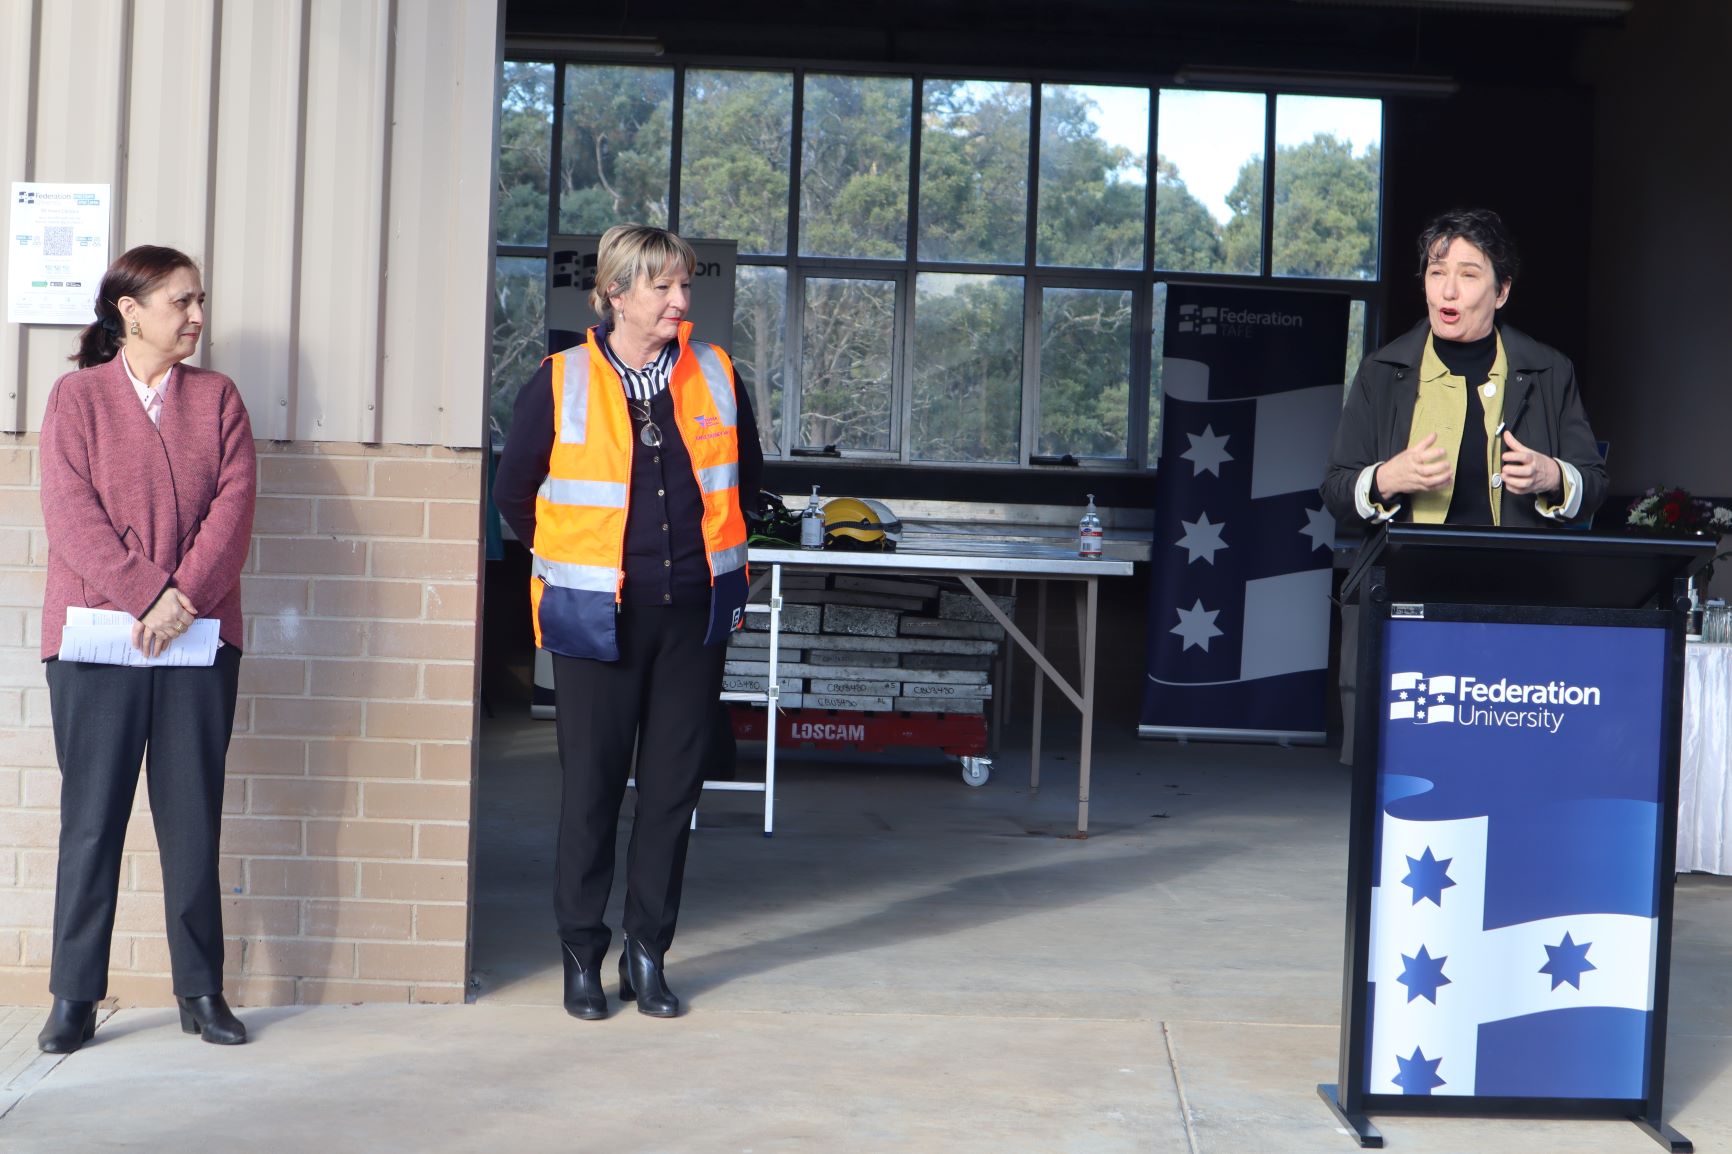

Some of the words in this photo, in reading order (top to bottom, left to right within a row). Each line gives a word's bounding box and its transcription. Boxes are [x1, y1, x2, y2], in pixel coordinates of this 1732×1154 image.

[1219, 307, 1303, 327] Federation
[1219, 323, 1256, 338] TAFE
[1459, 676, 1601, 706] Federation
[1458, 704, 1565, 733] University
[791, 723, 864, 741] LOSCAM
